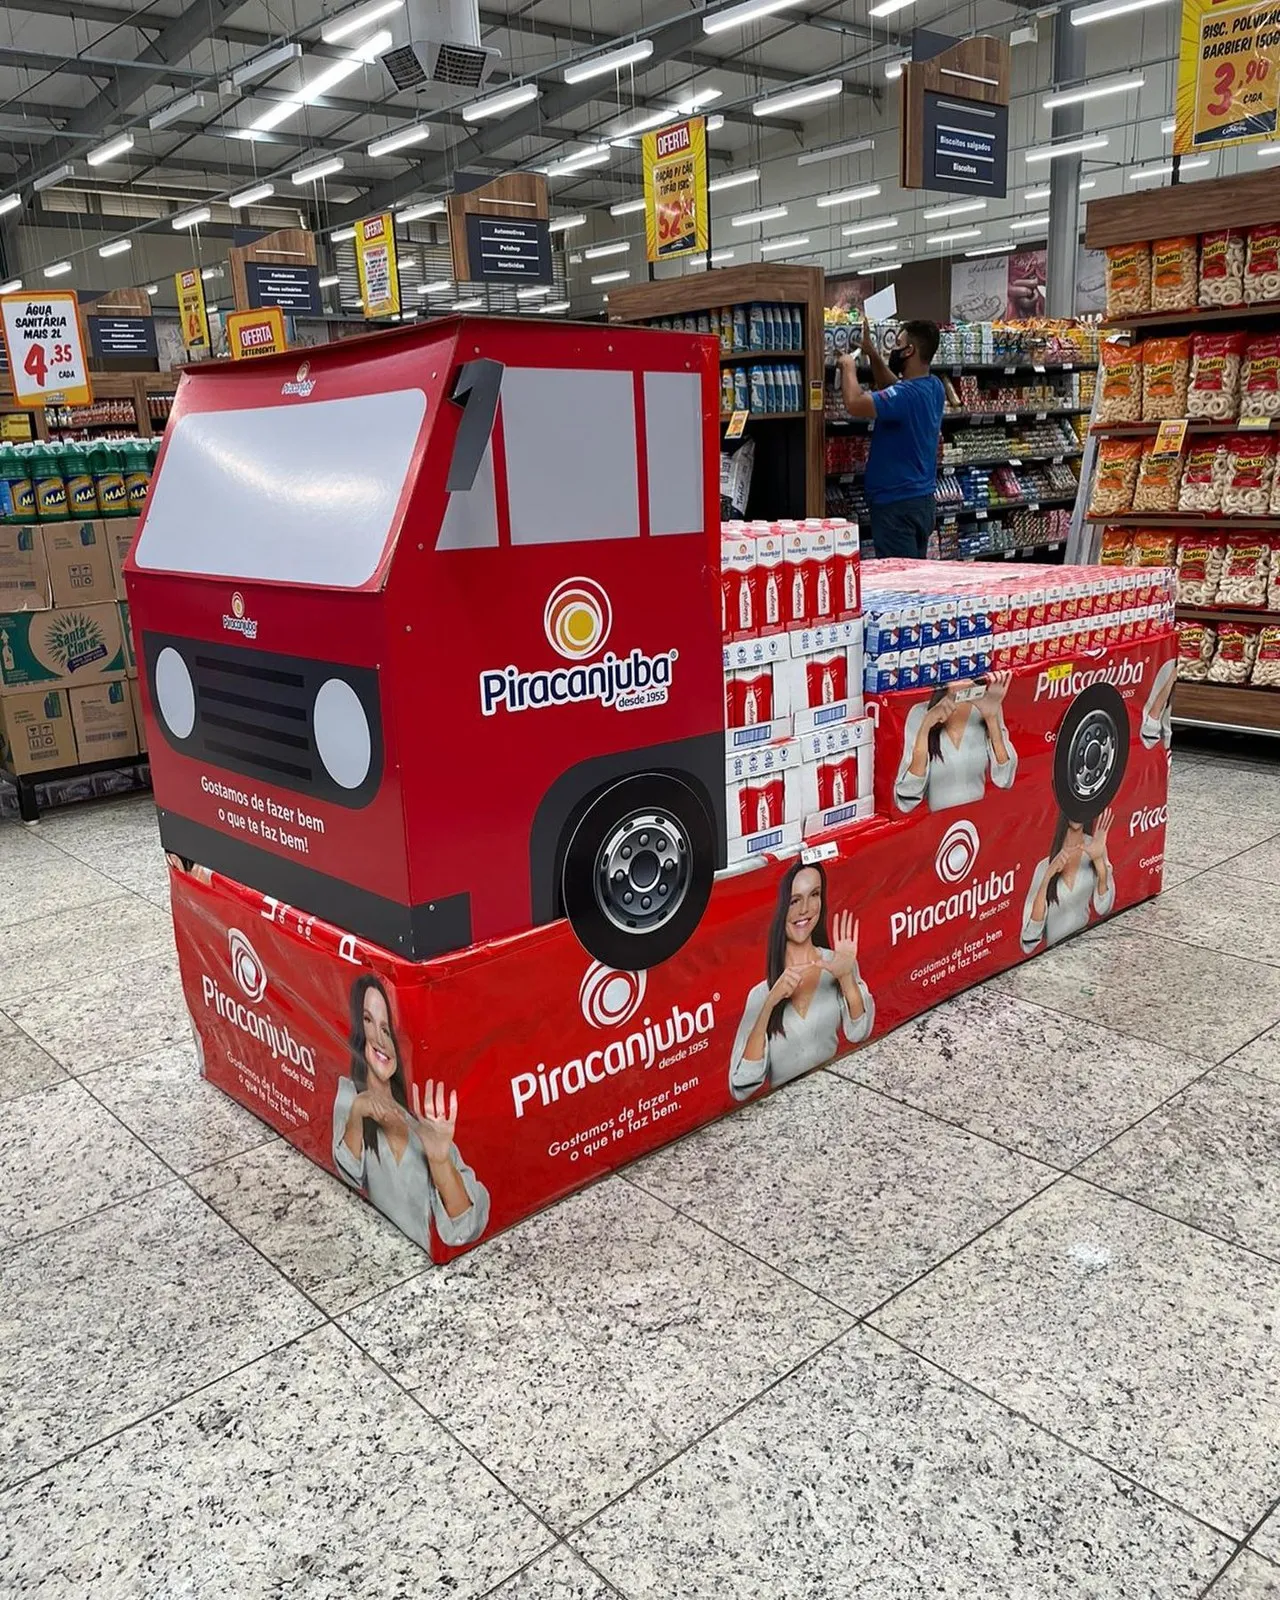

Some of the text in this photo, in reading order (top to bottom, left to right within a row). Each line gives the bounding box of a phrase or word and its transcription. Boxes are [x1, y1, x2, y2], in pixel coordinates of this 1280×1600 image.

[1203, 21, 1229, 40] BISC.
[1203, 37, 1252, 60] BARBIERI
[1243, 92, 1262, 104] CADA
[658, 126, 690, 155] OFERTA
[941, 135, 991, 151] Biscoitos salgados
[953, 162, 977, 173] Biscoitos
[494, 228, 525, 236] Automotivos
[500, 245, 521, 253] Petshop
[497, 261, 525, 269] Inseticidas
[26, 302, 52, 315] ÁGUA
[15, 314, 67, 328] SANITÁRIA
[24, 329, 62, 339] MAIS 2L
[241, 325, 273, 347] OFERTA
[58, 371, 75, 379] CADA
[56, 626, 87, 648] Santa
[67, 636, 99, 658] Clara
[482, 650, 672, 713] Piracanjuba
[618, 690, 666, 708] desde 1955
[201, 775, 325, 834] Gostamos de fazer bem
[218, 808, 309, 854] o que te faz bem!
[890, 869, 1015, 946] Piracanjuba
[910, 929, 1003, 981] Gostamos de fazer bem
[922, 947, 992, 987] o que te faz bem.
[202, 974, 316, 1077] Piracanjuba
[510, 1001, 715, 1119] Piracanjuba
[658, 1037, 709, 1070] desde 1955
[227, 1050, 310, 1122] Gostamos de fazer bem
[239, 1073, 244, 1083] o
[245, 1078, 258, 1095] que
[266, 1090, 280, 1112] faz
[548, 1075, 699, 1157] Gostamos de fazer bem
[570, 1102, 682, 1162] o que te faz bem.
